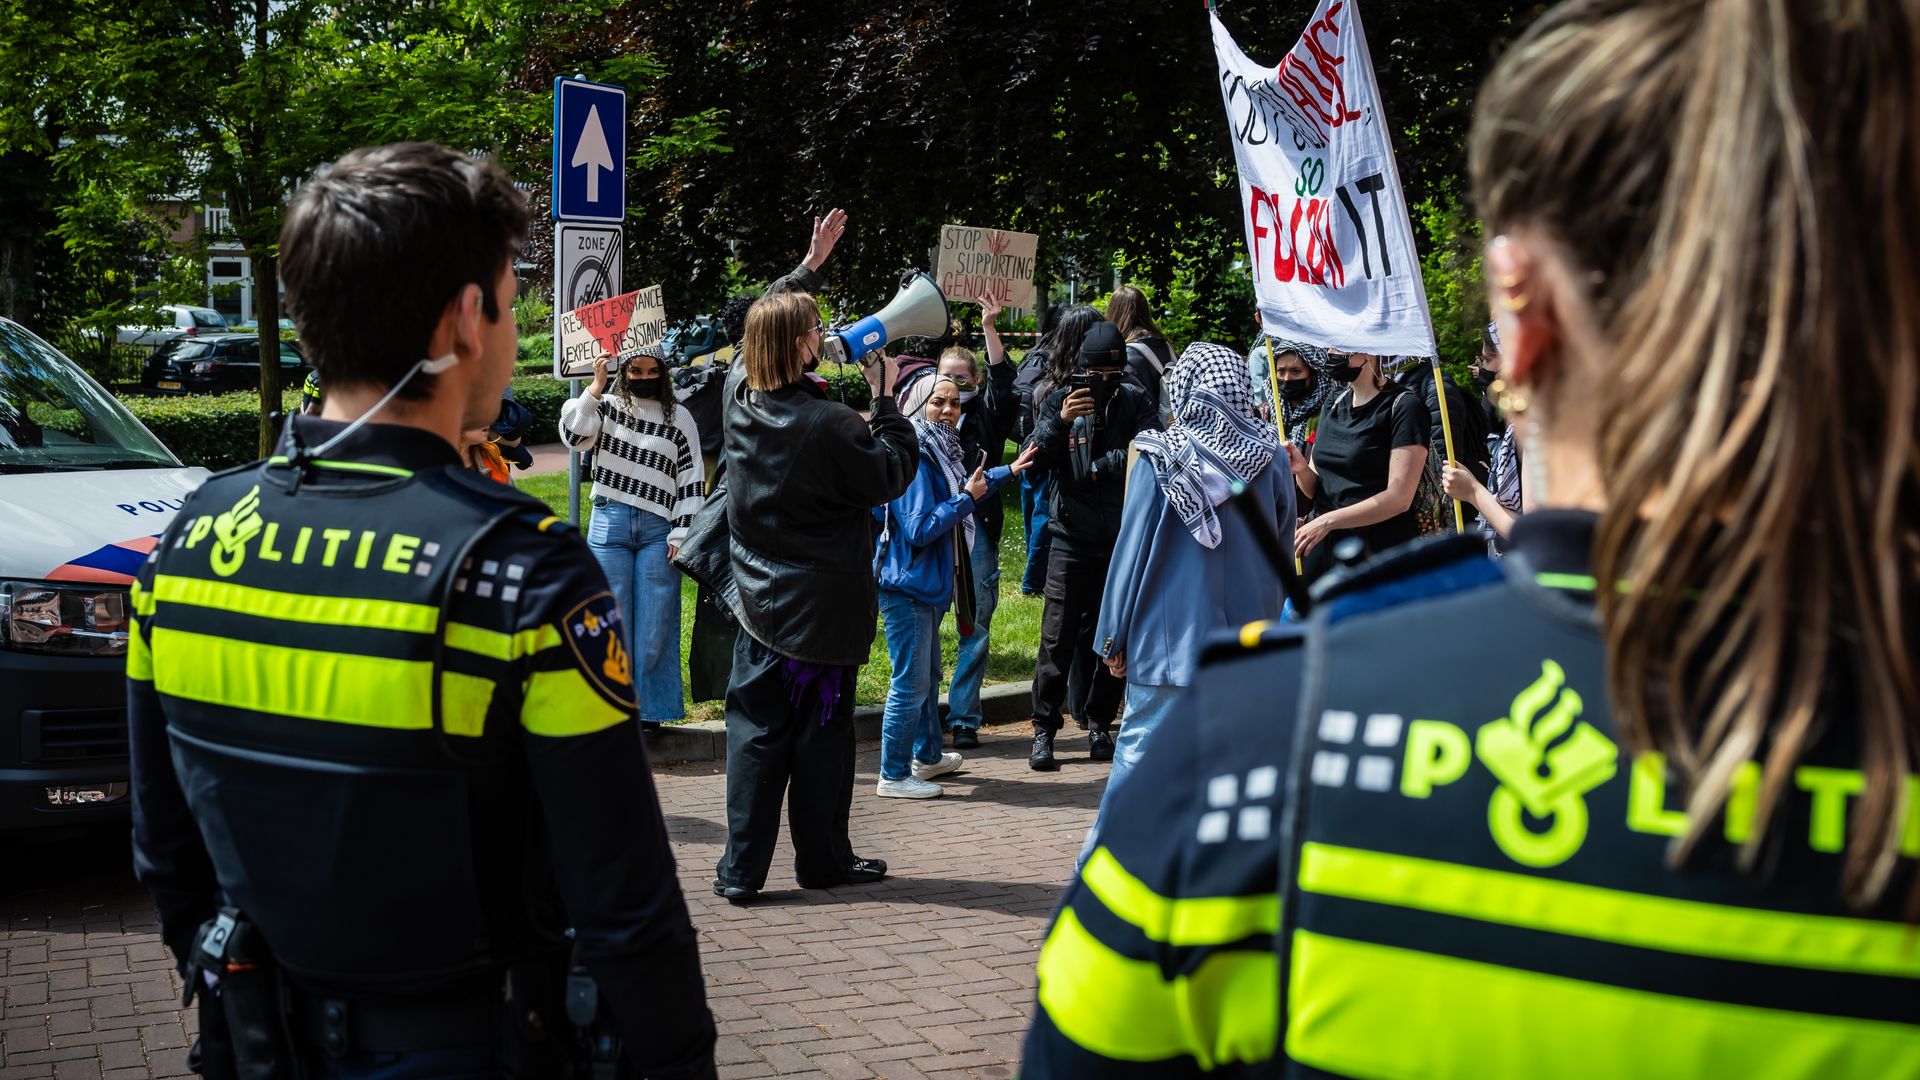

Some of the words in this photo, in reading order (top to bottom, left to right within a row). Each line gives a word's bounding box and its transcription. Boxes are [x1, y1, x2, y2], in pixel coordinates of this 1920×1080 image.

[1295, 157, 1325, 197] SO
[578, 236, 605, 250] ZONE
[944, 228, 982, 251] STOP
[1335, 172, 1392, 280] IT
[957, 252, 1033, 280] SUPPORTING
[943, 272, 1014, 302] GENOCIDE
[562, 303, 606, 335] RESPECT
[611, 287, 663, 317] EXISTANCE
[605, 319, 616, 329] OR
[566, 338, 604, 363] EXPECT
[611, 318, 667, 353] RESISTANCE
[185, 494, 422, 577] POLITIE
